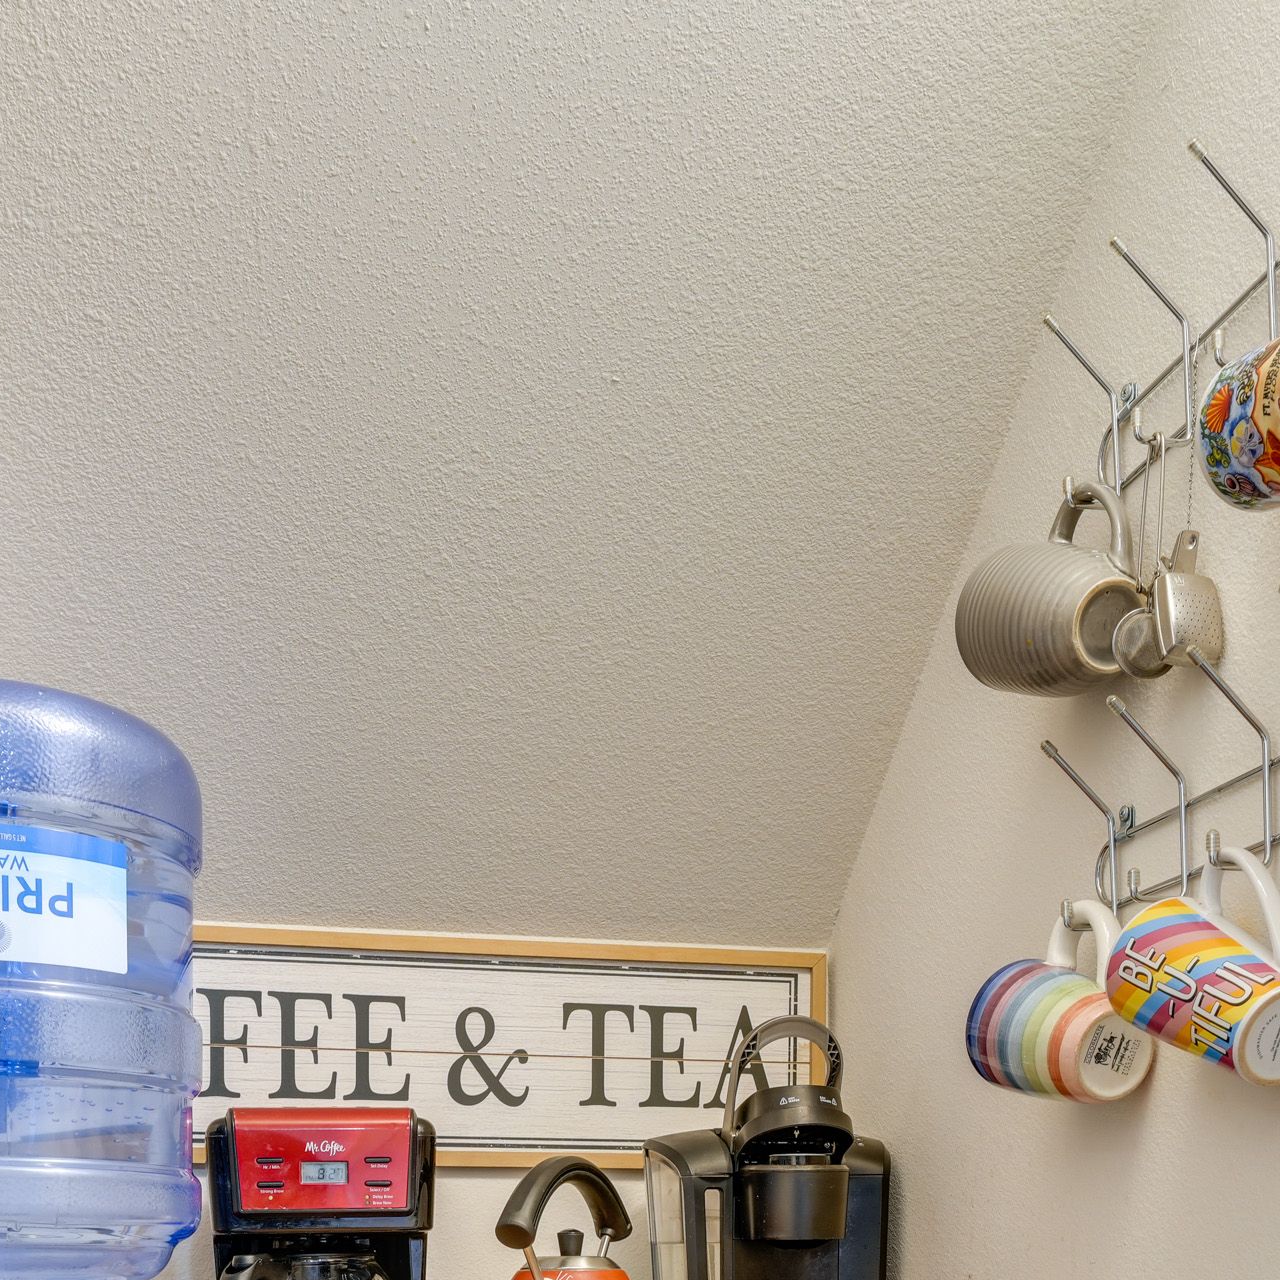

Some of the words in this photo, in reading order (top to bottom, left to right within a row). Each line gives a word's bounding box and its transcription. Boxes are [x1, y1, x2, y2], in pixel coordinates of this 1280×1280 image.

[1263, 369, 1276, 400] MYERS
[1263, 401, 1271, 417] FT.
[1118, 937, 1167, 994] BE
[1190, 960, 1275, 1057] TIFUL
[190, 988, 411, 1102] FEE
[447, 1006, 530, 1107] &
[562, 1001, 771, 1109] TEA
[304, 1141, 320, 1155] Mr.
[320, 1140, 346, 1157] Coffee
